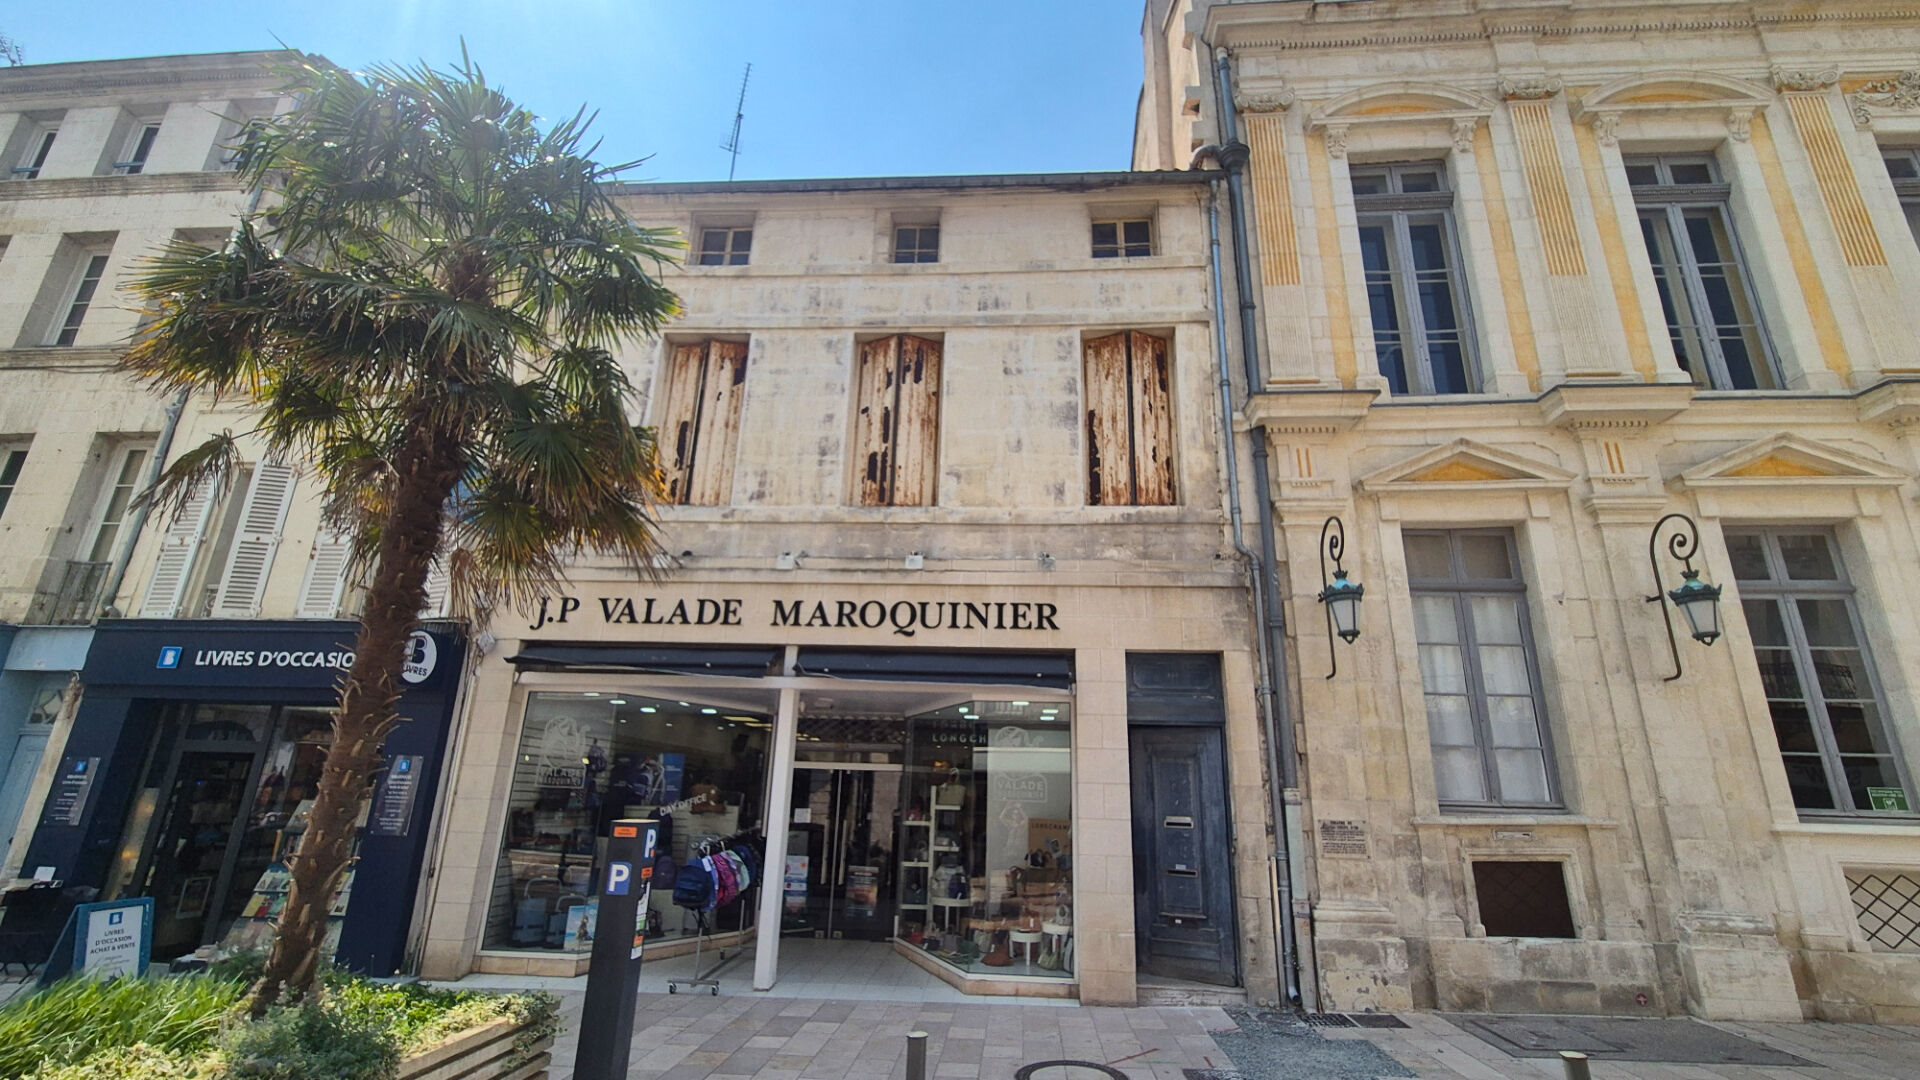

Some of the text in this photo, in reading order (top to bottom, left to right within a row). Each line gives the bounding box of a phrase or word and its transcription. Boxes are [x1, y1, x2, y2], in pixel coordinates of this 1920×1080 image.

[530, 597, 1061, 637] J.P VALADE MAROQUINIER
[195, 651, 356, 668] LIVRES D'OCCASIO
[998, 780, 1044, 791] VALADE
[608, 864, 630, 891] P
[104, 928, 124, 936] LIVRES
[95, 935, 132, 946] D'OCCASION
[90, 946, 110, 954] ACHAT
[117, 942, 135, 950] VENTE
